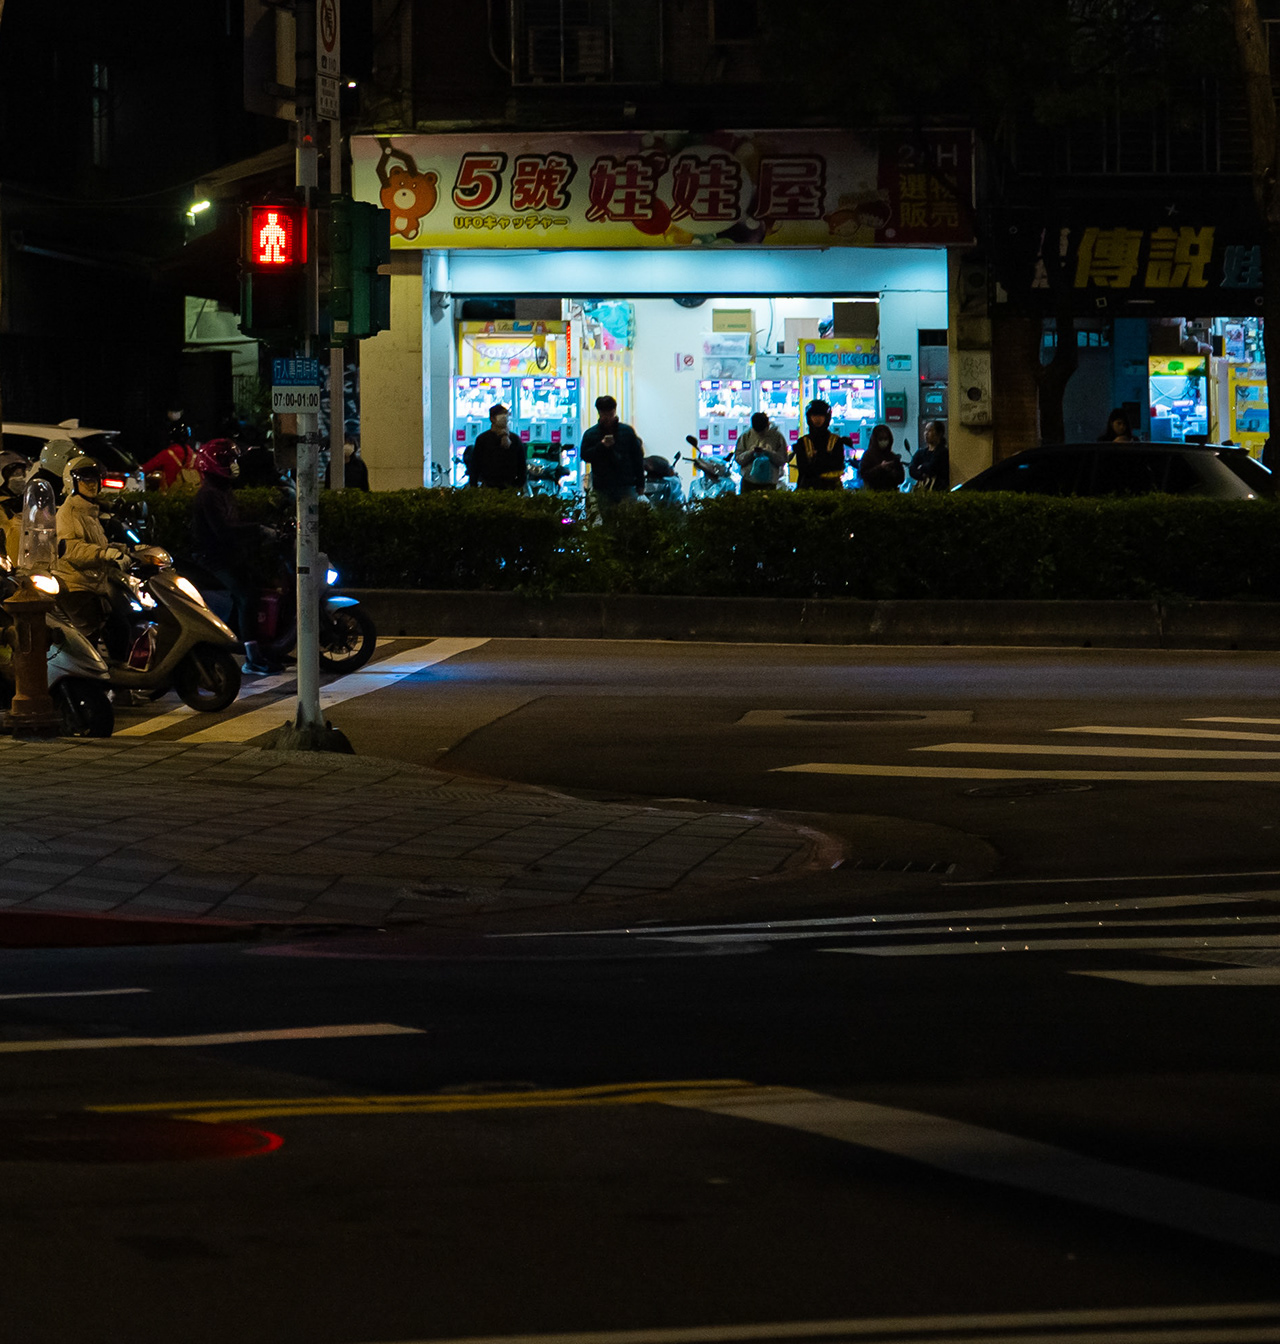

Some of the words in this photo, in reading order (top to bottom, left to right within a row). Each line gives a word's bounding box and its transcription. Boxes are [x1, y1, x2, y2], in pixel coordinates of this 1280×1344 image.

[452, 151, 826, 223] 5號娃娃屋
[453, 215, 569, 231] UFOキャッチャー
